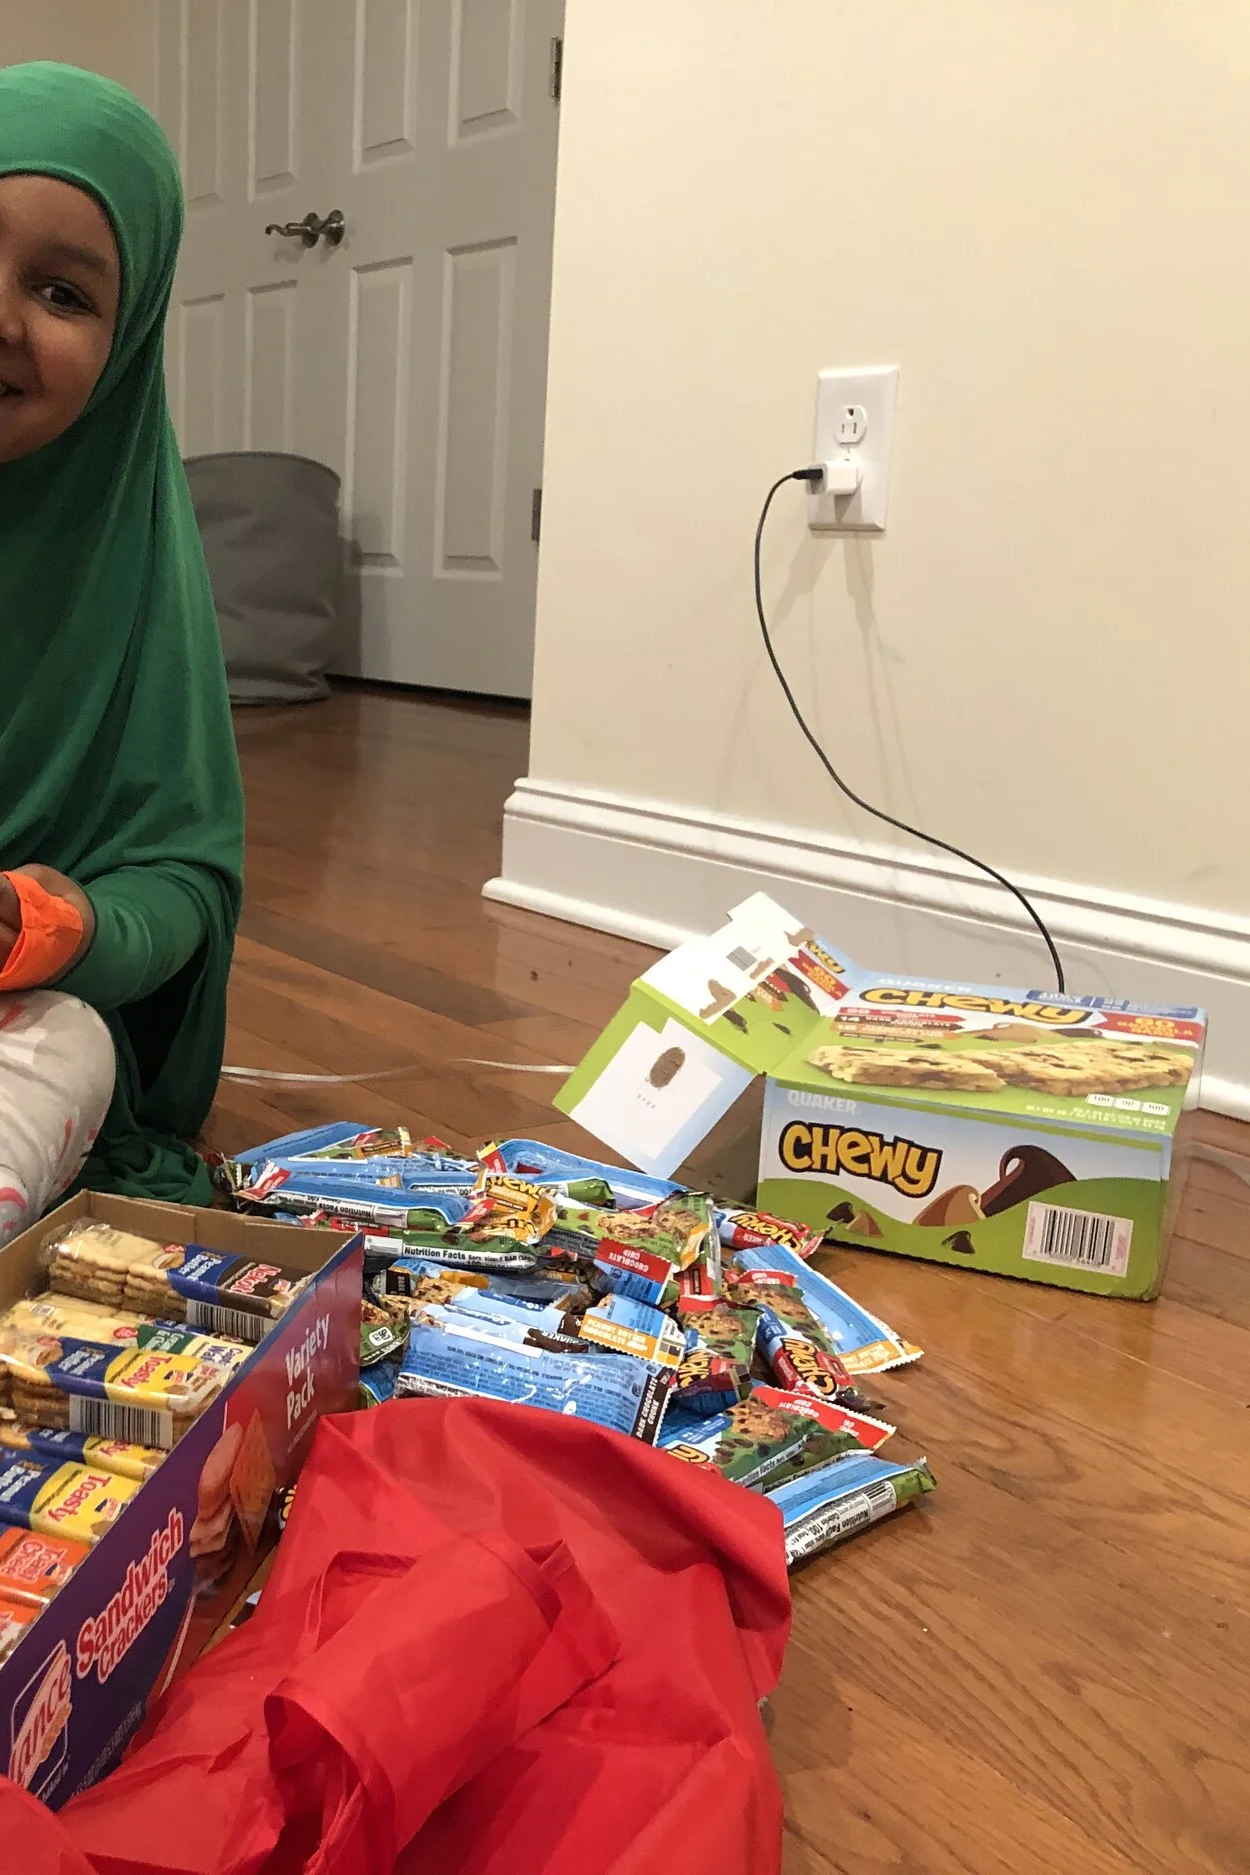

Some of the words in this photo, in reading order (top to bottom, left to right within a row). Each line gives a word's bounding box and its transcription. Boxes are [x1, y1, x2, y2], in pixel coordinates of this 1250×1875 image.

[787, 1090, 857, 1114] QUAKER
[404, 1246, 441, 1258] Nutrition
[442, 1250, 467, 1260] Facts
[608, 1251, 650, 1273] CHOCOLATE
[120, 1355, 173, 1389] Toasty
[285, 1312, 330, 1387] Variety
[286, 1366, 316, 1430] Pack
[636, 1418, 646, 1438] DARK
[641, 1377, 658, 1417] CHOCOLATE
[646, 1400, 660, 1425] CHUNK
[47, 1473, 112, 1522] Toasty
[76, 1507, 183, 1679] Sandwich
[98, 1567, 168, 1684] Crackers
